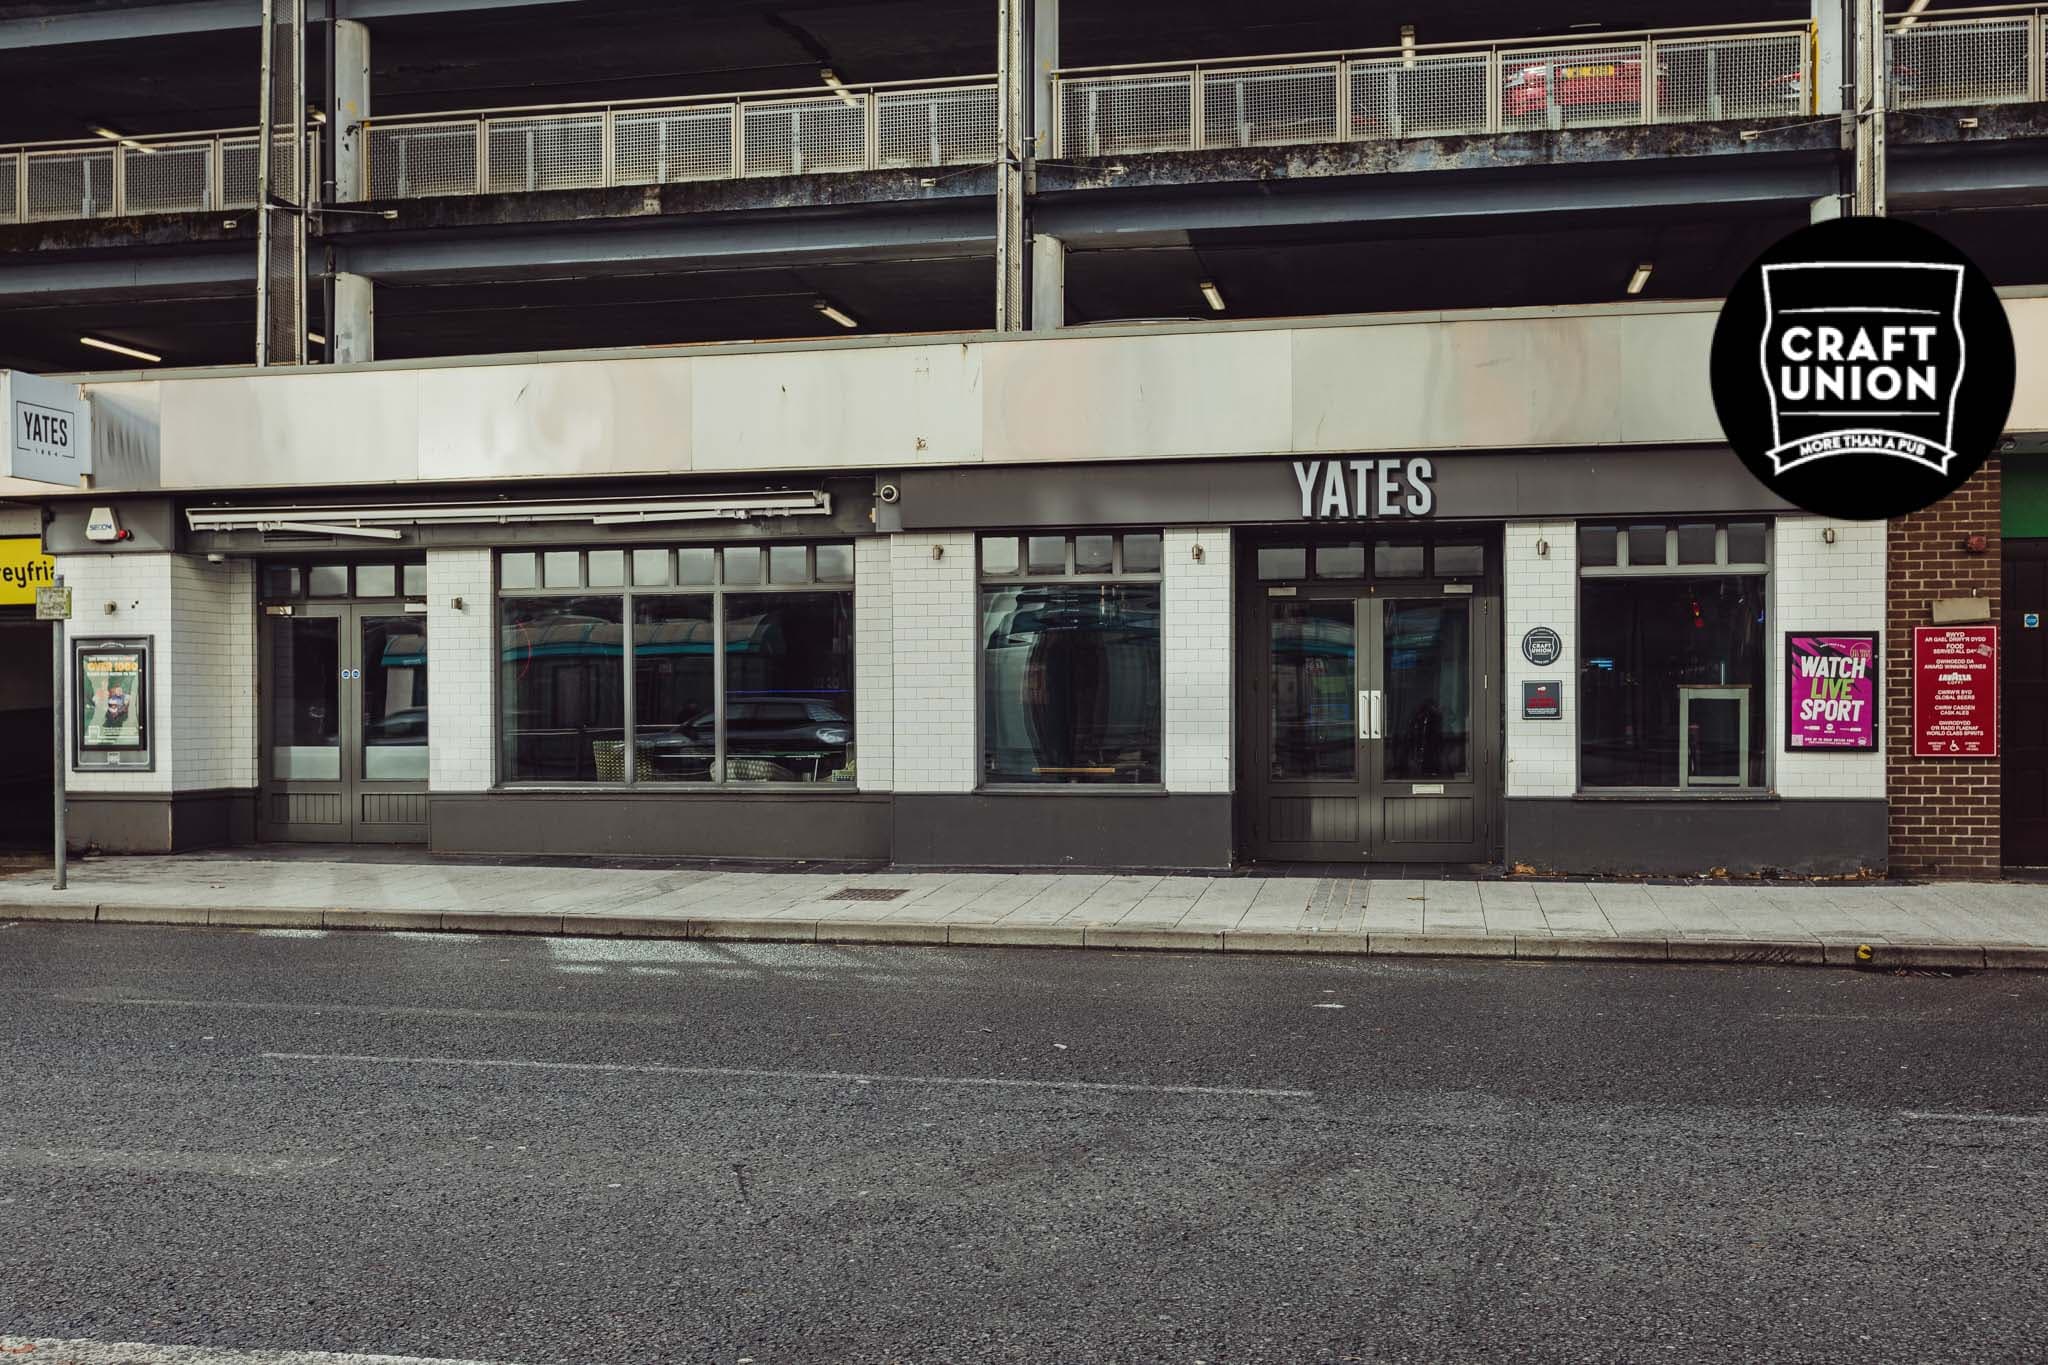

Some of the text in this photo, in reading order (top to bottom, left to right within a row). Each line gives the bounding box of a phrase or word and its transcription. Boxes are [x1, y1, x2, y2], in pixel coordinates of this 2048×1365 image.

[23, 411, 68, 447] YATES
[1293, 457, 1433, 517] YATES
[0, 560, 55, 588] eyfri
[1801, 655, 1866, 679] WATCH
[1810, 678, 1855, 699] LIVE
[1799, 698, 1865, 722] SPORT
